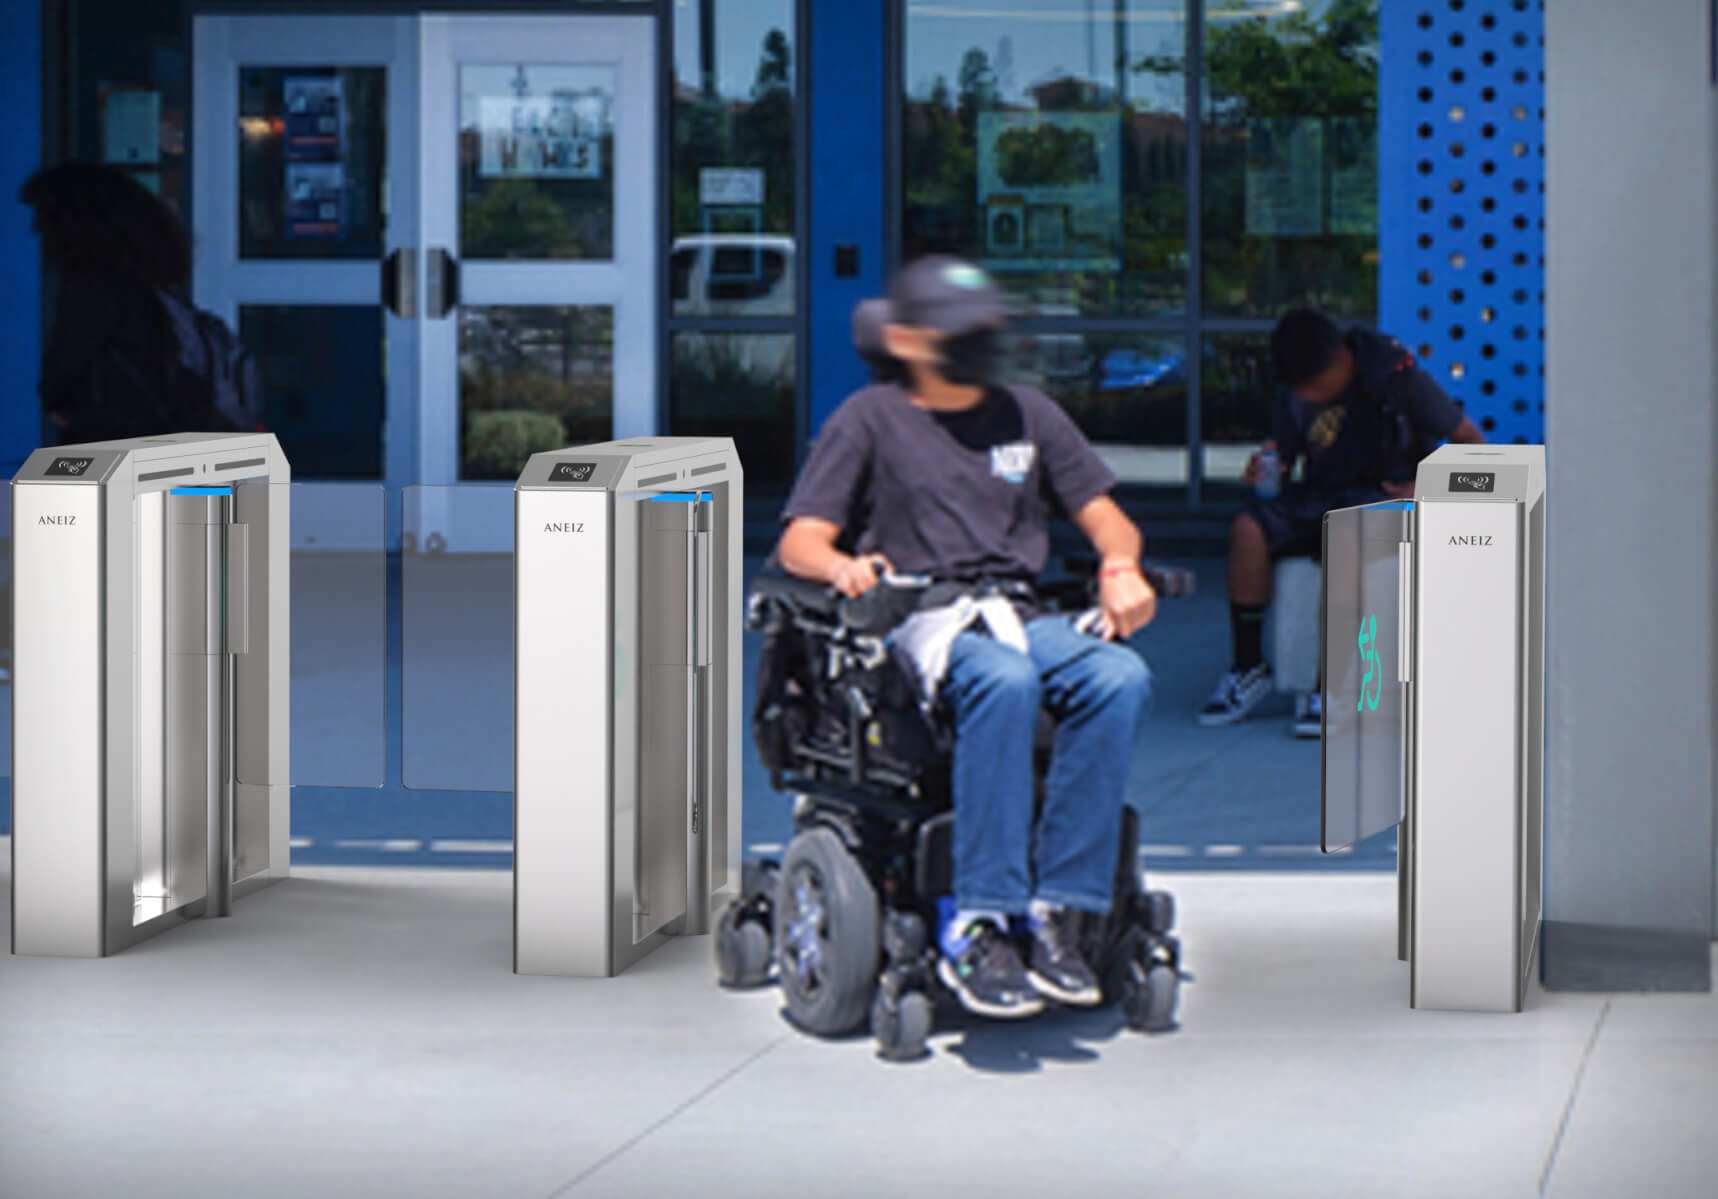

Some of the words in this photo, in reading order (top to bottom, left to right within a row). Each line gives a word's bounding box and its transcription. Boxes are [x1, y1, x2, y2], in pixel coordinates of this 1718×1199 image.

[38, 515, 76, 525] ANEIZ
[544, 523, 584, 533] ANEIZ
[1448, 536, 1493, 546] ANEIZ
